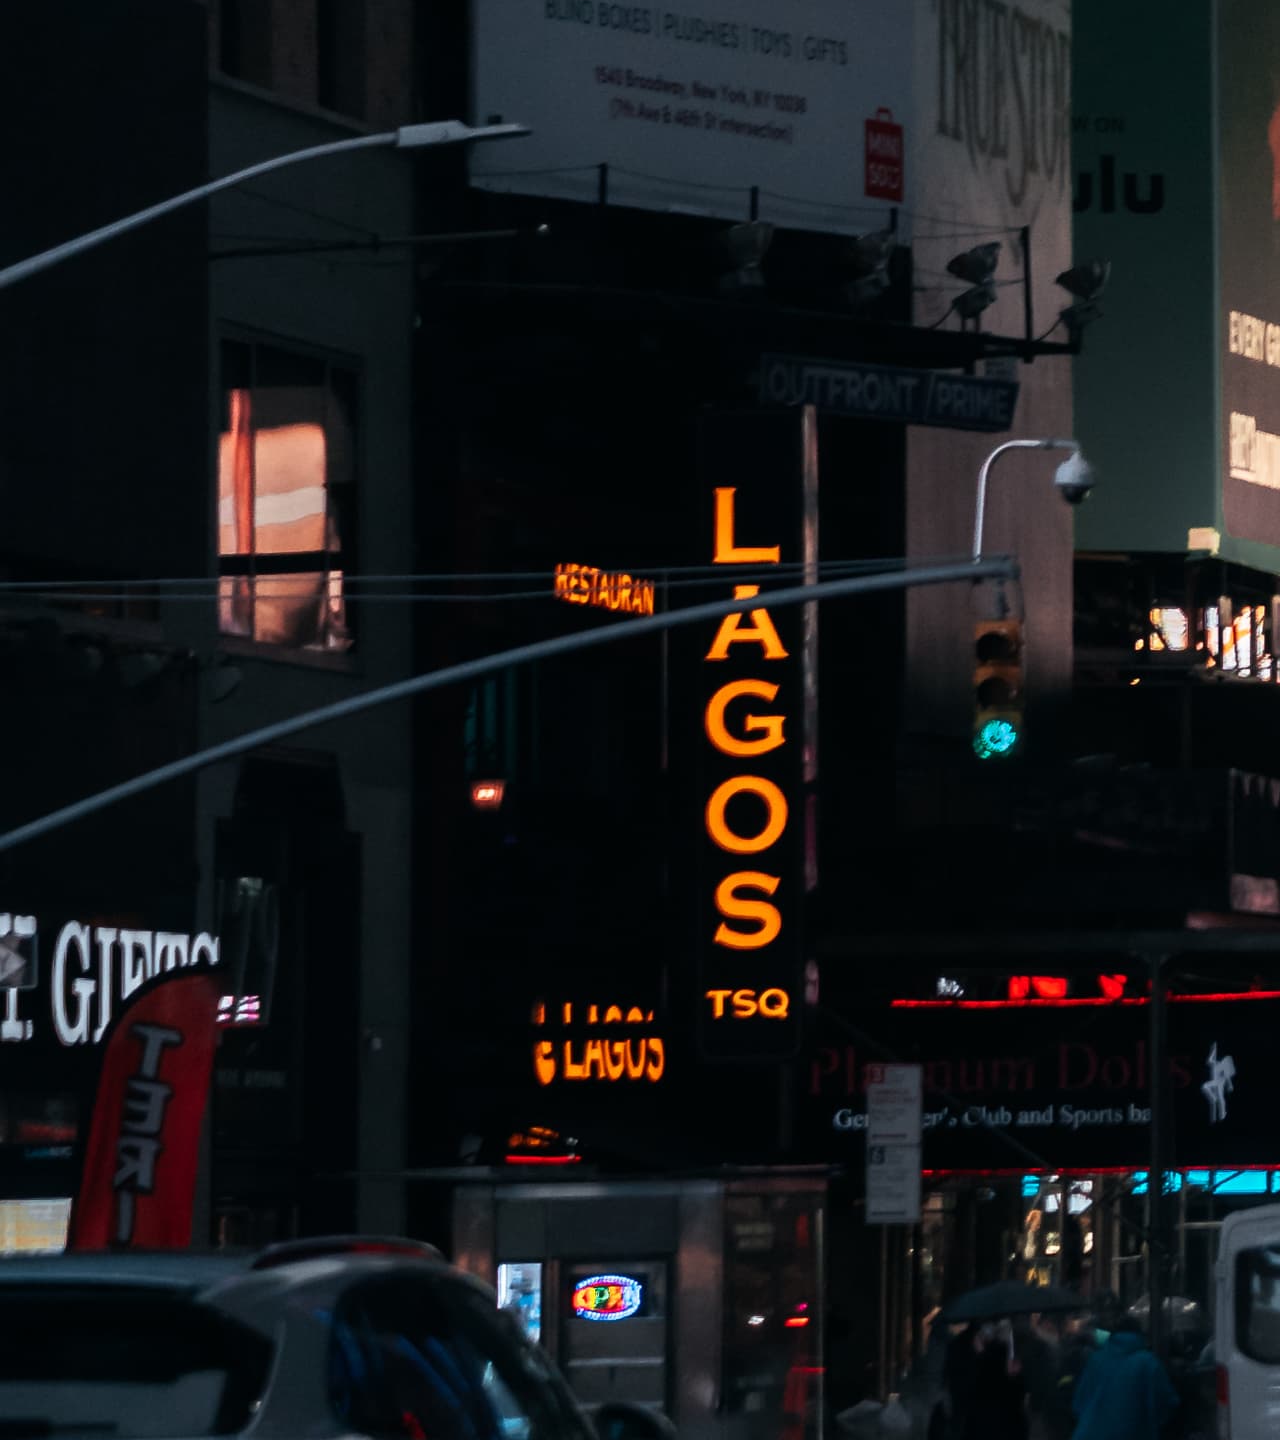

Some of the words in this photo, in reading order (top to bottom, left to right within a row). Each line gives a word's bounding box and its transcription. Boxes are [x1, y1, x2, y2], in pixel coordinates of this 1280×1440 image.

[597, 1, 652, 35] BOXES
[664, 13, 740, 50] PLUSHIES
[752, 28, 792, 58] TOYS
[803, 37, 849, 66] GIFTS
[637, 102, 659, 122] Ave
[693, 81, 718, 101] New
[754, 90, 772, 109] NY
[704, 485, 790, 951] LAGOS
[704, 986, 791, 1022] TSQ
[1057, 1039, 1193, 1090] Dols
[962, 1104, 1012, 1130] Club
[1017, 1104, 1057, 1128] and
[1062, 1104, 1123, 1134] Sports
[1129, 1099, 1152, 1124] ba
